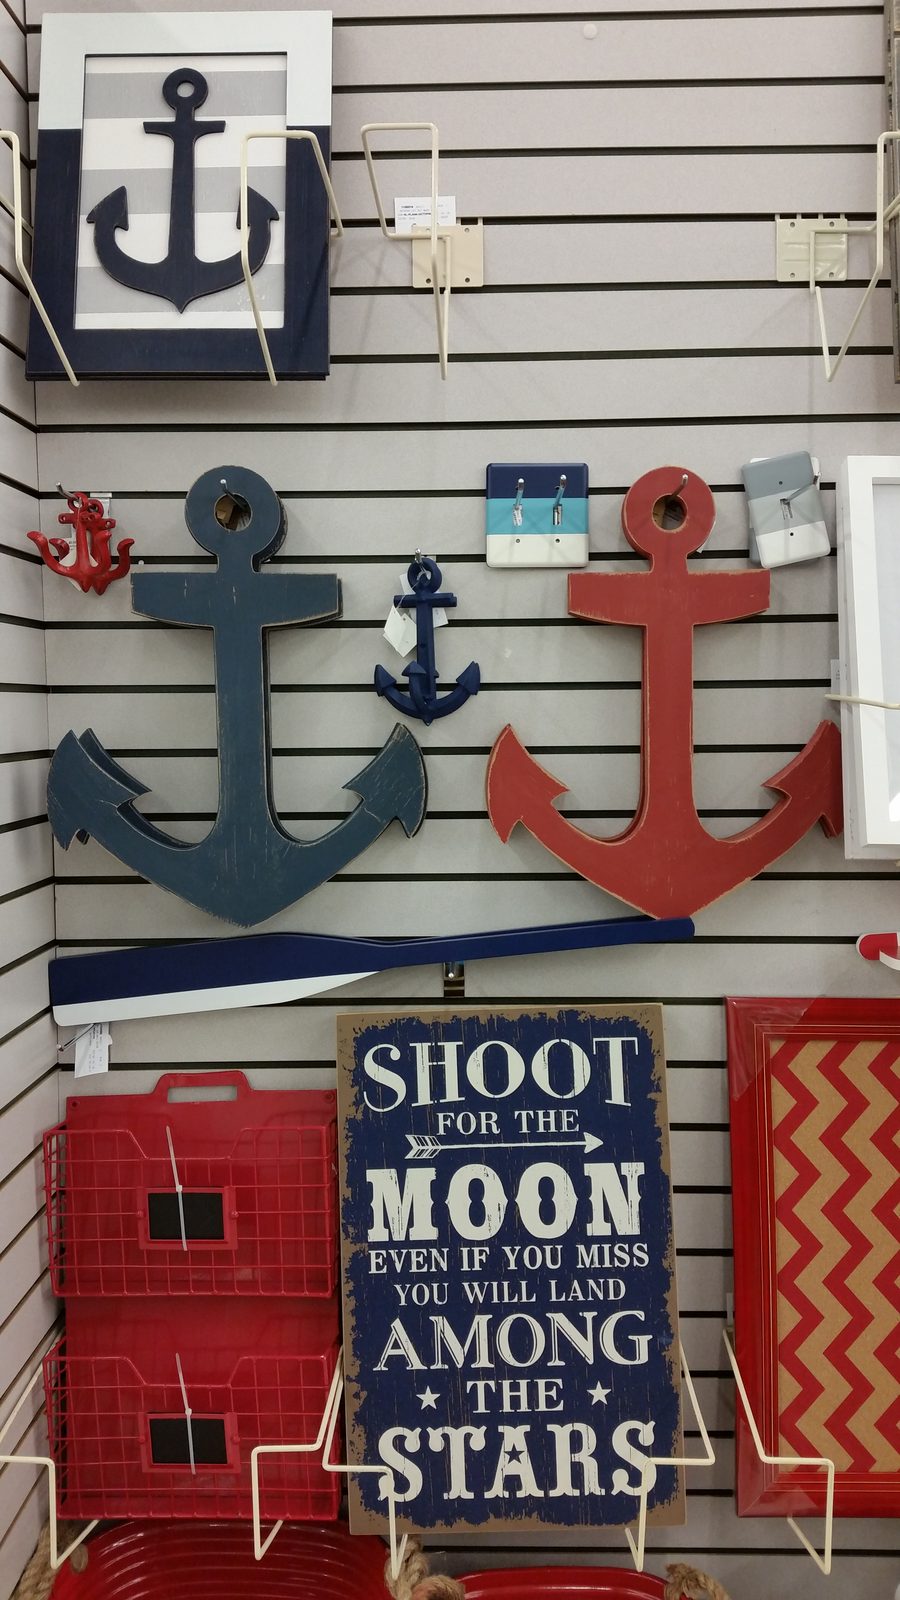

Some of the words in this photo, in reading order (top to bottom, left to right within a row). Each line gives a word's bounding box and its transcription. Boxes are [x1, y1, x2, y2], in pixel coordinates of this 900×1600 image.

[363, 1036, 639, 1112] SHOOT
[436, 1111, 501, 1135] FOR
[514, 1109, 580, 1133] THE
[365, 1161, 645, 1242] MOON
[368, 1248, 449, 1274] EVEN
[460, 1247, 490, 1271] IF
[502, 1245, 563, 1270] YOU
[576, 1243, 650, 1268] MISS
[394, 1283, 449, 1306] YOU
[462, 1281, 537, 1303] WILL
[549, 1278, 626, 1301] LAND
[372, 1310, 653, 1371] AMONG
[466, 1378, 564, 1413] THE
[377, 1419, 658, 1503] STARS
